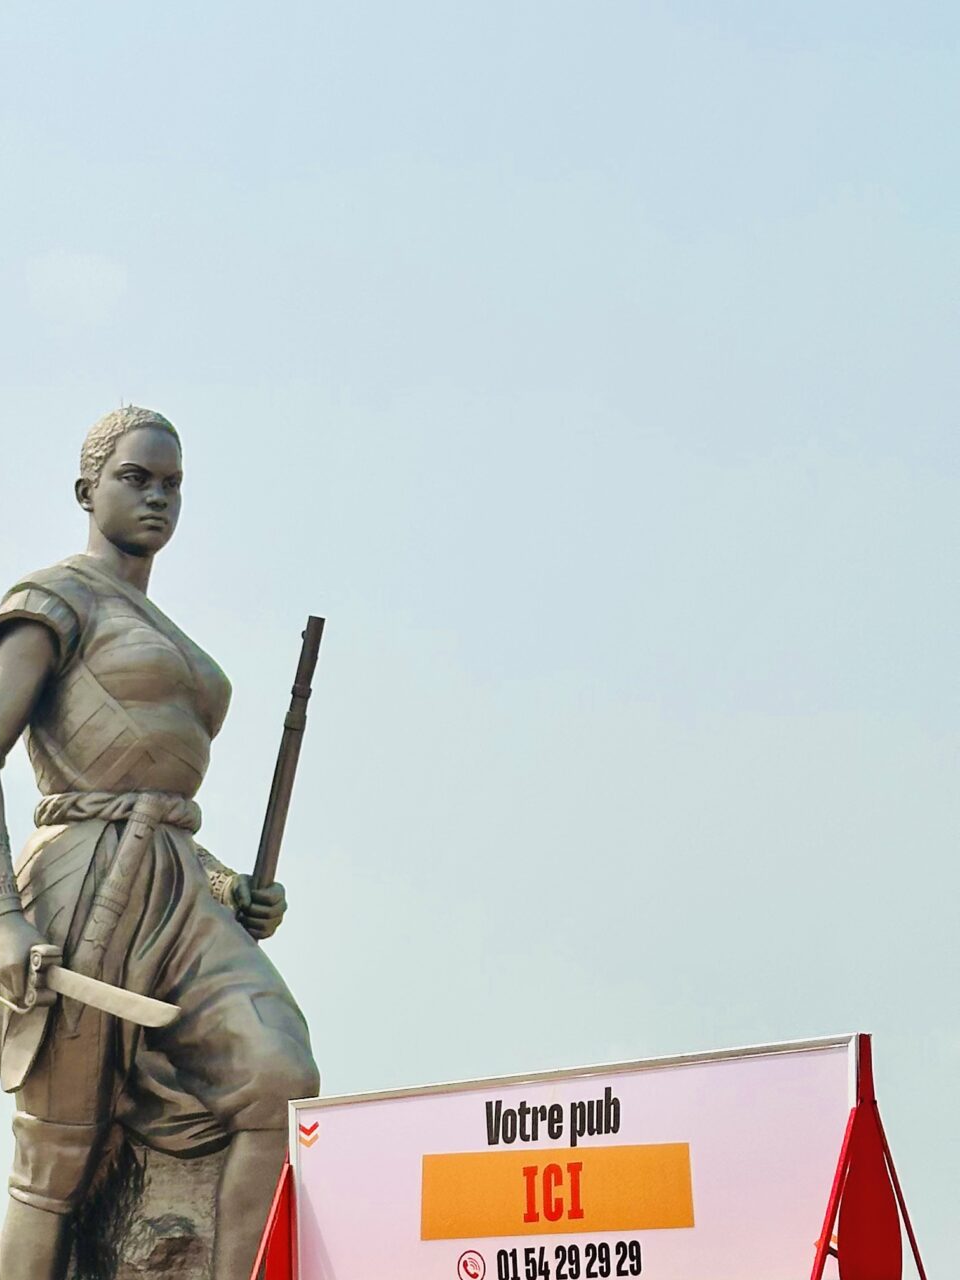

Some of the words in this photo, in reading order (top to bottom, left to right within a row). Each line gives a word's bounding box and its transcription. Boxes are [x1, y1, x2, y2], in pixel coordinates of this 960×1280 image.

[485, 1100, 563, 1146] Votre
[570, 1087, 621, 1147] pub
[523, 1161, 584, 1223] ICI
[554, 1244, 581, 1280] 29
[585, 1242, 611, 1279] 29
[615, 1240, 642, 1277] 29
